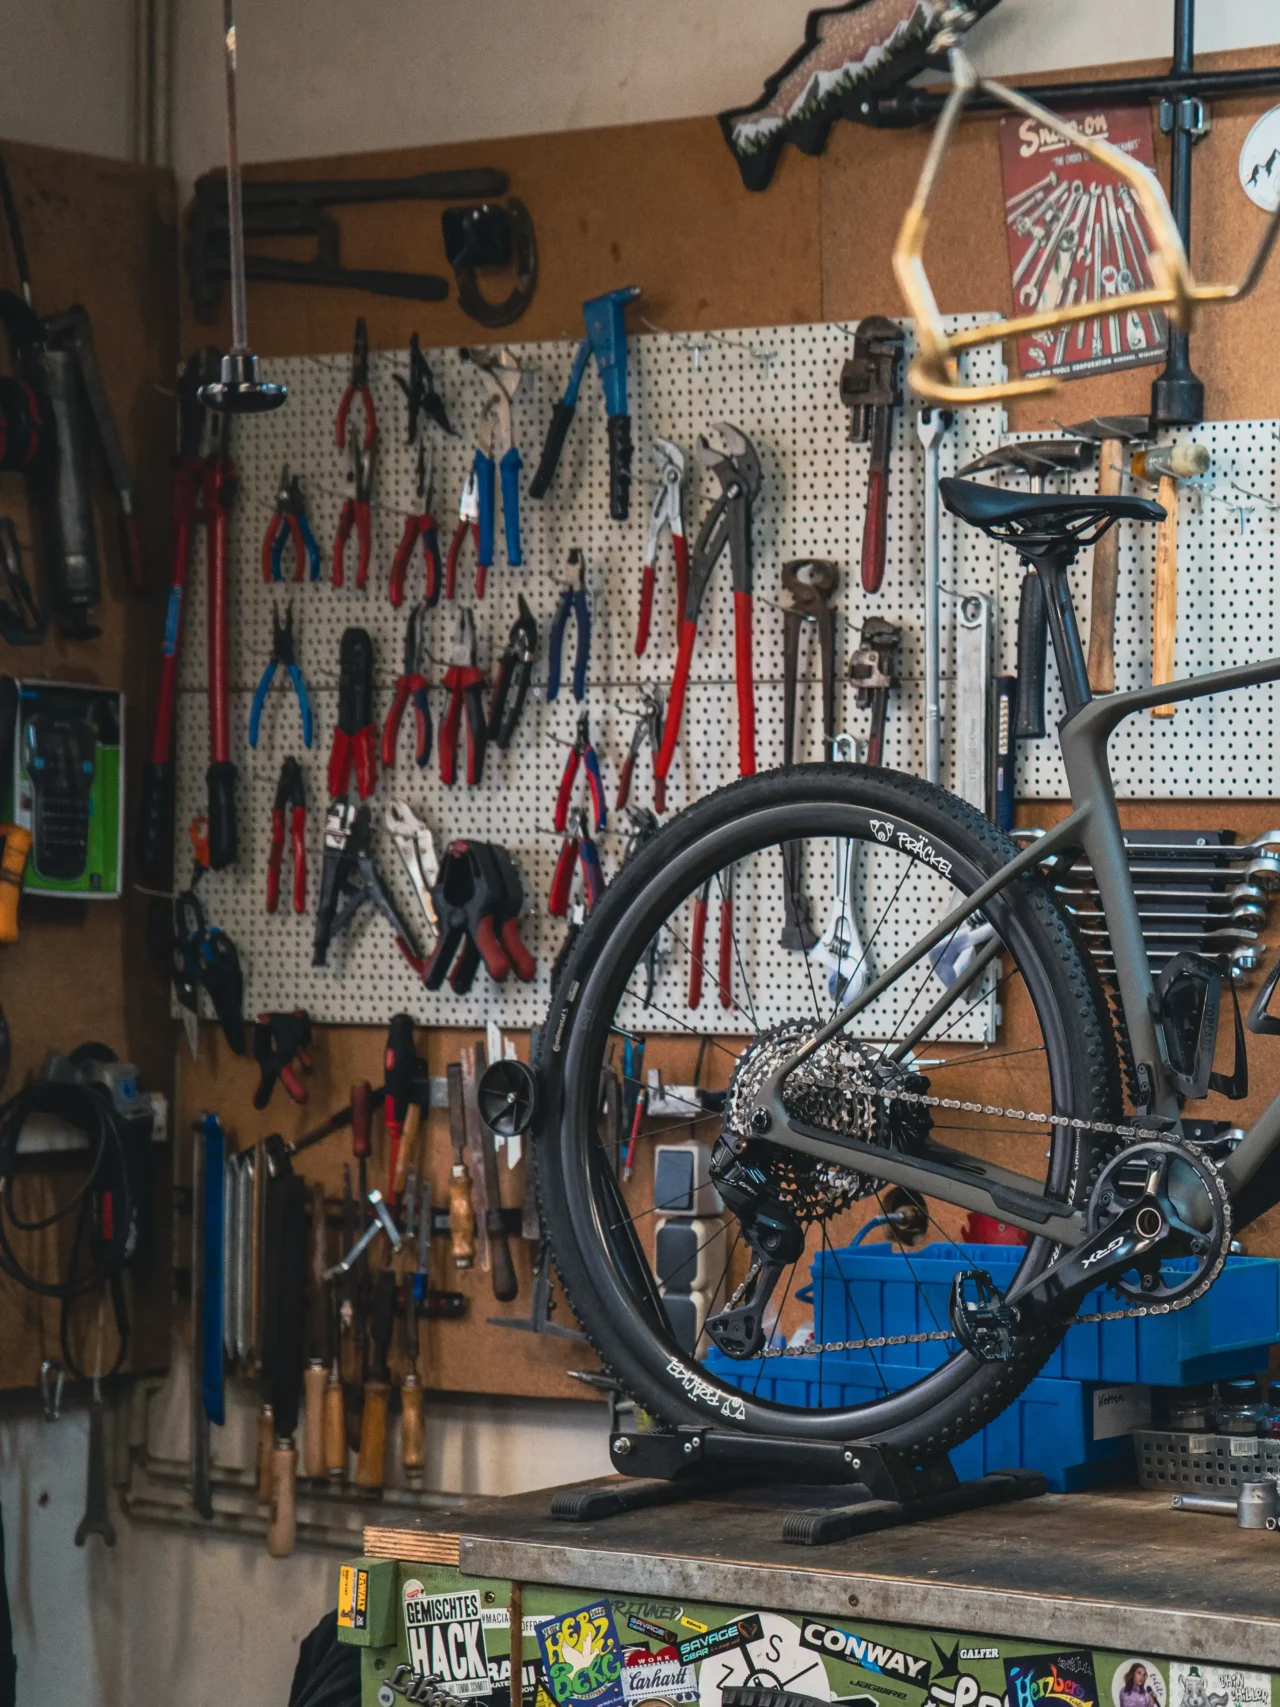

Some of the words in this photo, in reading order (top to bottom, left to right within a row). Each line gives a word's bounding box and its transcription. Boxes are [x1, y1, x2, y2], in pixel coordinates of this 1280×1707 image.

[1072, 1128, 1080, 1166] ontinental
[1081, 1236, 1125, 1269] GRX
[406, 1595, 479, 1624] GEMISCHTES
[629, 1616, 665, 1636] SAVAGE
[680, 1625, 740, 1655] SAVAGE
[408, 1621, 487, 1681] HACK
[637, 1654, 671, 1665] WORK
[682, 1647, 709, 1663] GEAR
[804, 1624, 927, 1679] CONWAY
[960, 1648, 999, 1660] GALFER
[629, 1667, 688, 1691] Carhartt
